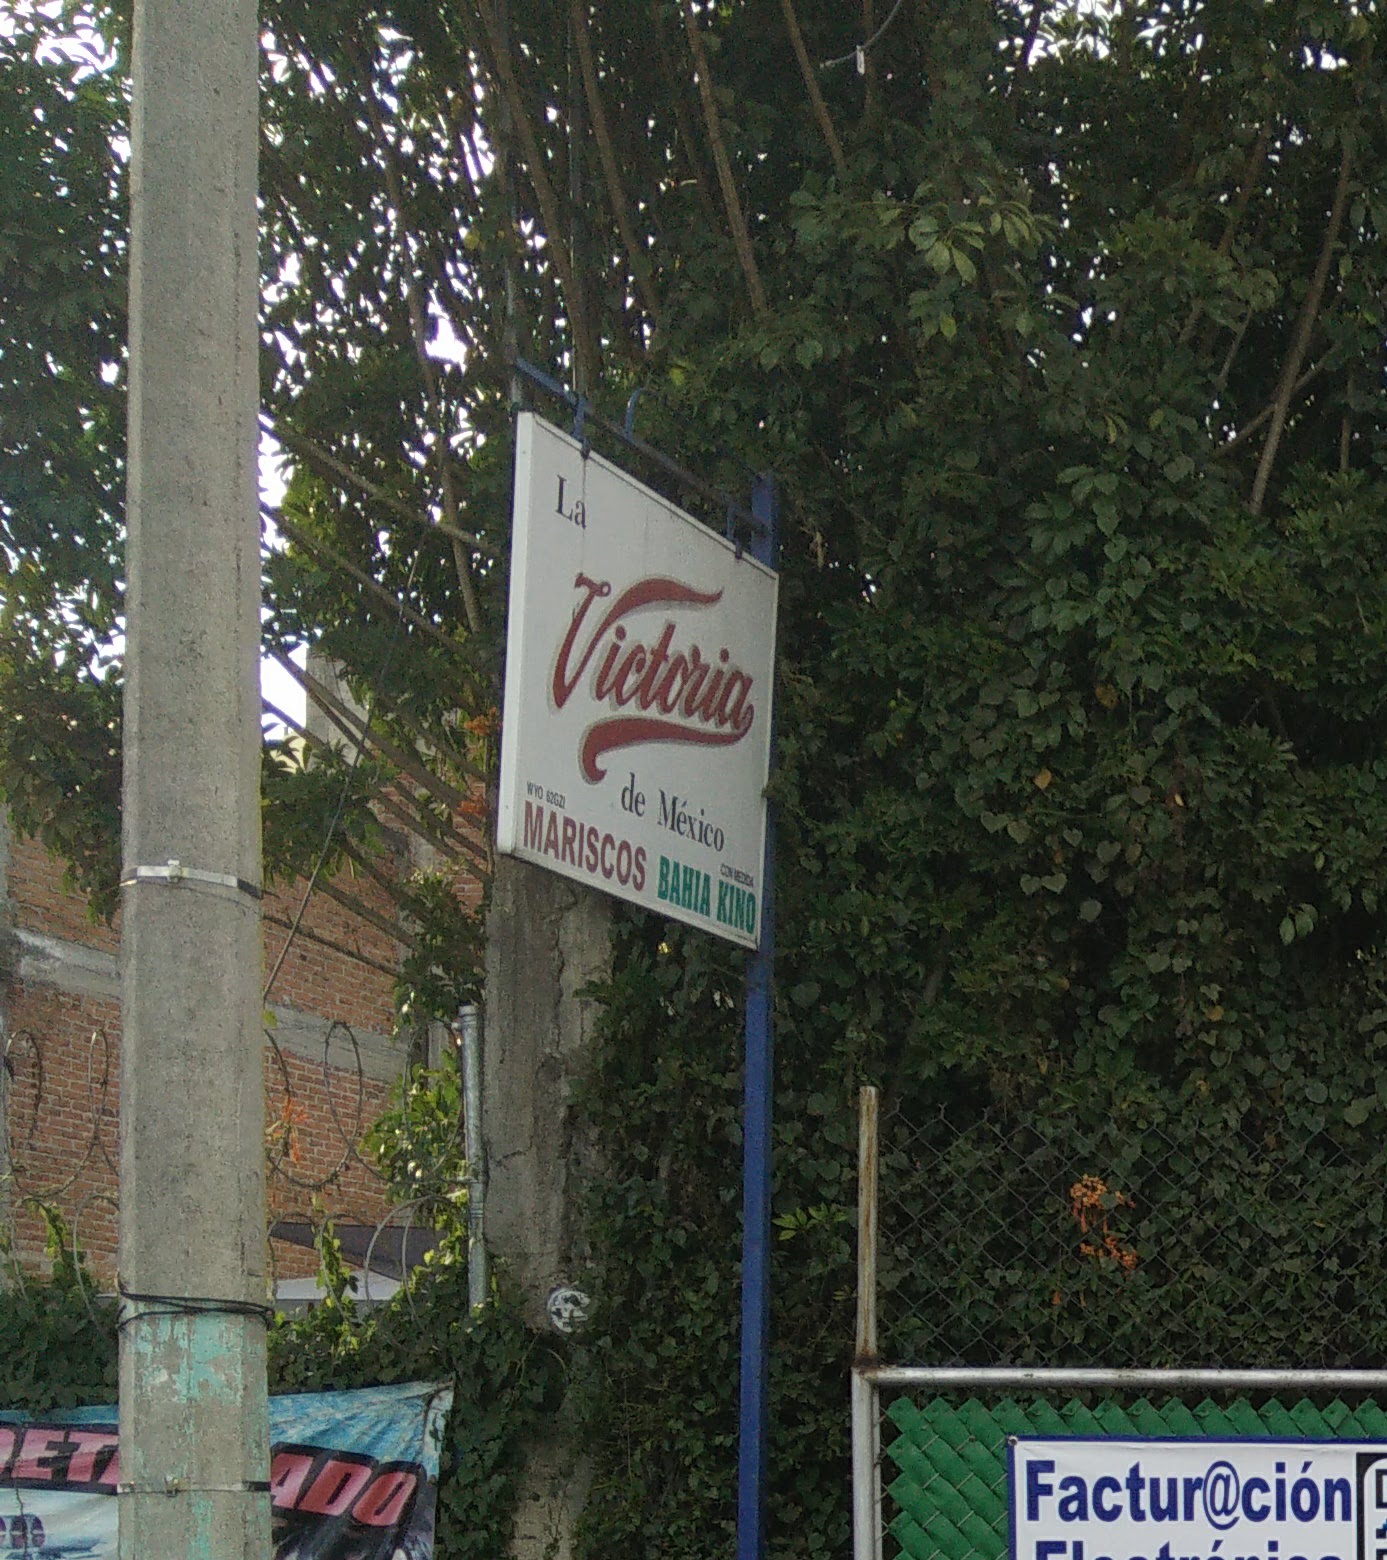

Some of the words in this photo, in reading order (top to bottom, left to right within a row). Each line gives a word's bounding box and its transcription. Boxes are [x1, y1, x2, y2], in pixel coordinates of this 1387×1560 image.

[556, 475, 588, 529] La
[552, 571, 755, 740] Victoria
[621, 772, 646, 817] de
[658, 788, 725, 852] México
[523, 800, 647, 892] MARISCOS
[657, 854, 711, 918] BAHIA
[717, 878, 757, 934] KINO
[1025, 1459, 1353, 1531] Factur@ción
